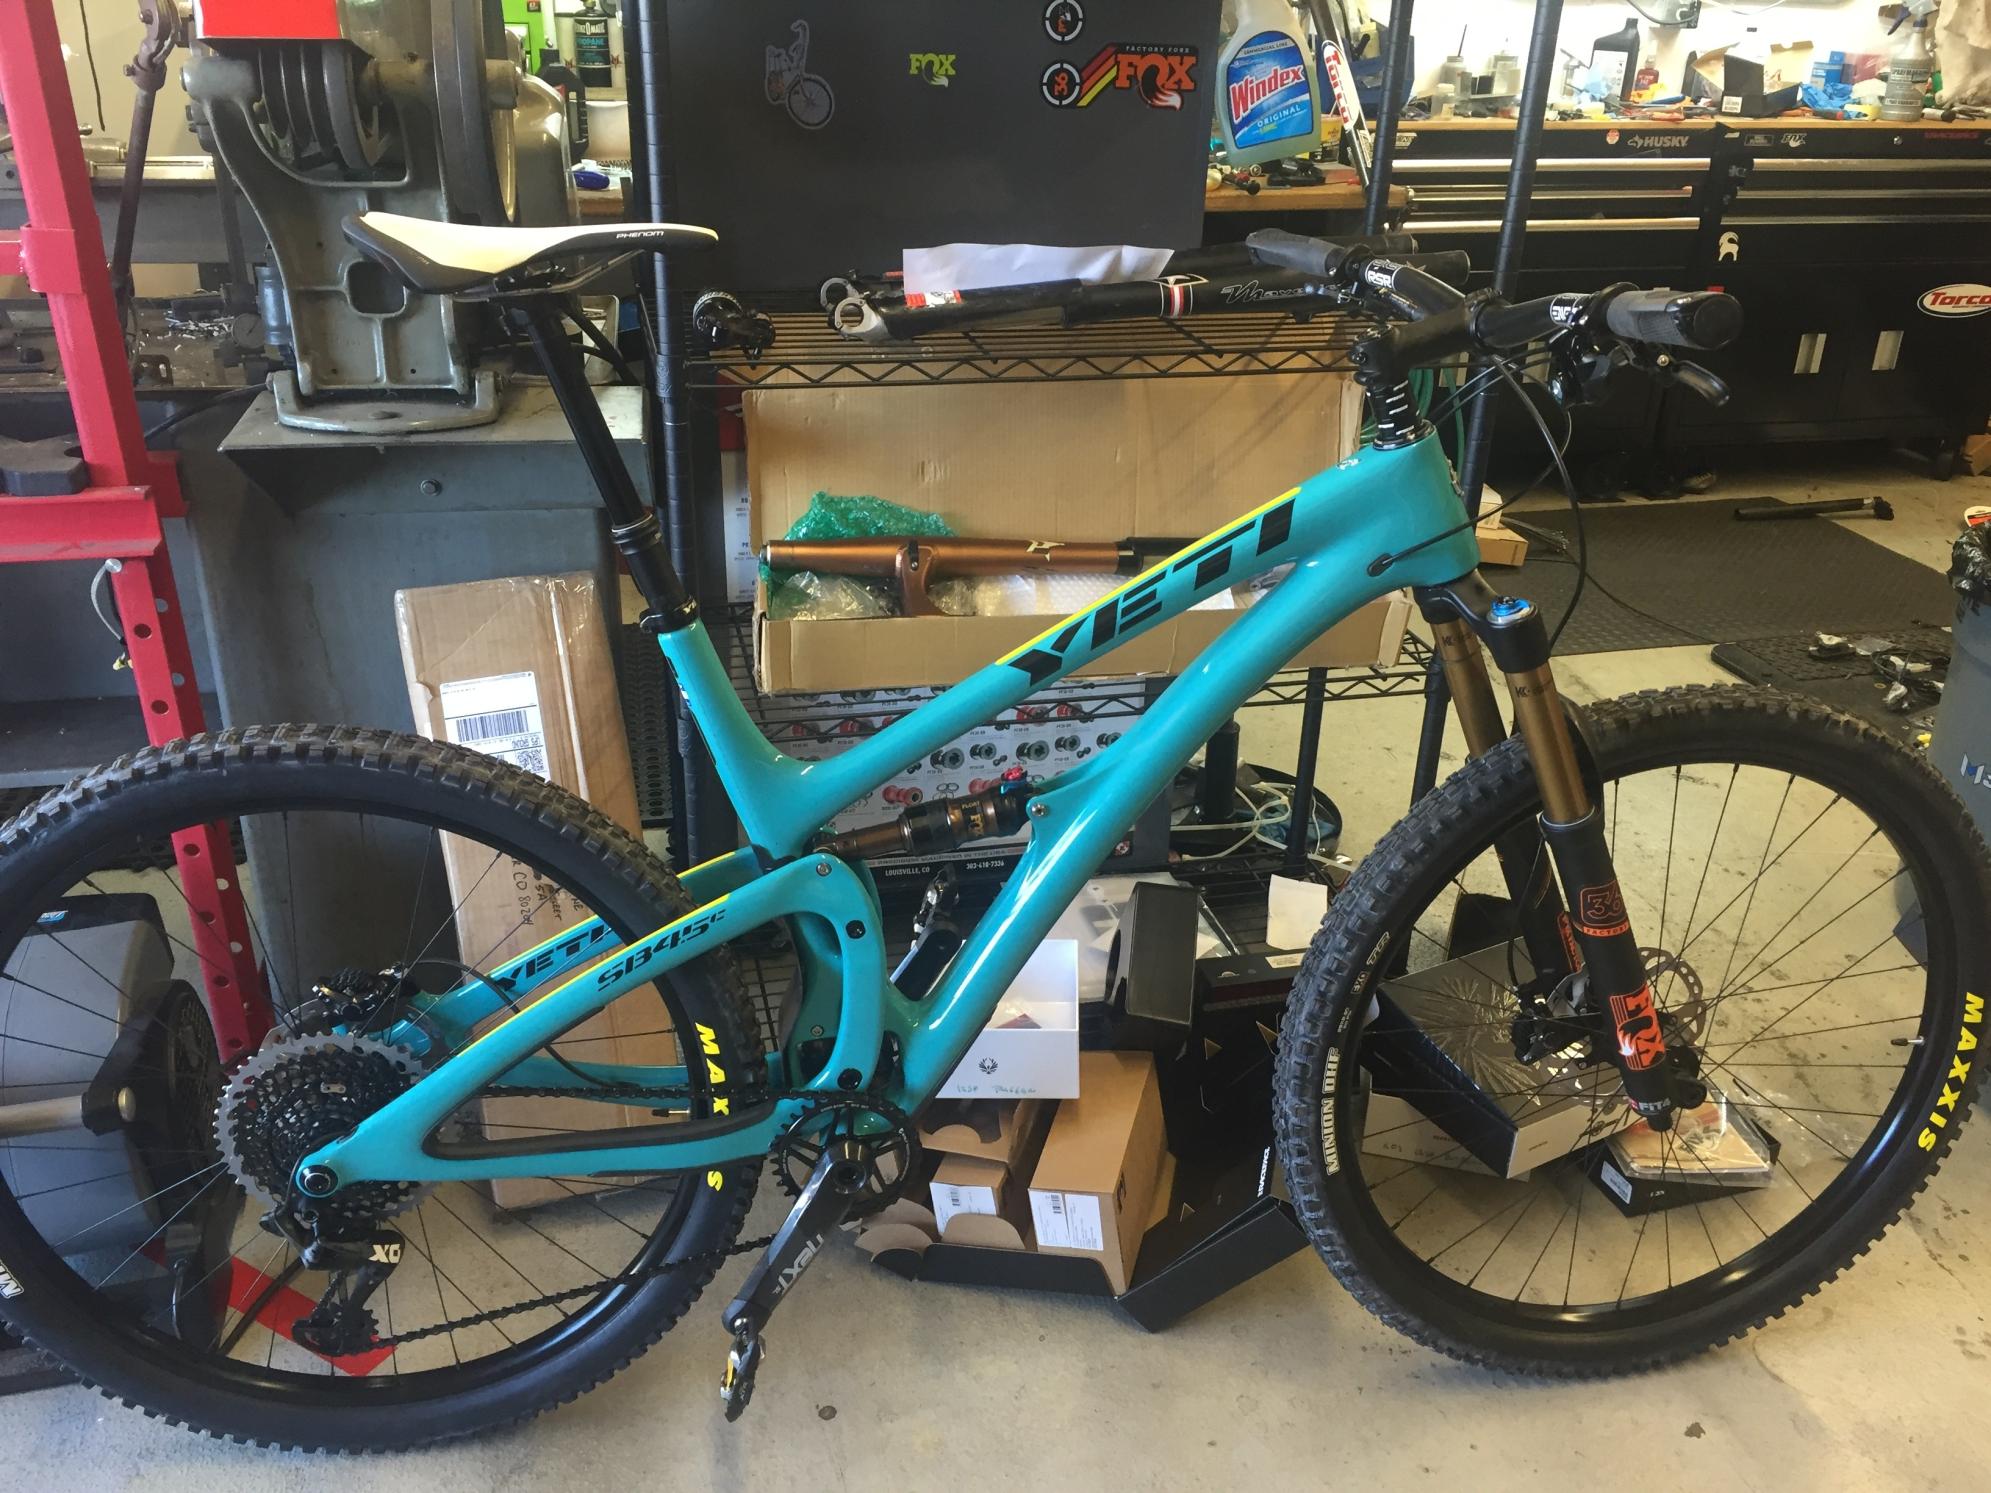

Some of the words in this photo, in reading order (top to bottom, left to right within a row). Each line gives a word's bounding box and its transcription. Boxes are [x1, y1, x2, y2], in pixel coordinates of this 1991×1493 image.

[909, 53, 956, 88] FOX
[1054, 72, 1069, 96] 36
[1115, 53, 1197, 111] FOX
[1229, 64, 1305, 125] Windex
[1256, 105, 1301, 128] ORIGINAL
[1643, 135, 1690, 148] HUSKY
[615, 230, 665, 240] PHENOM
[1008, 497, 1297, 688] YETI
[885, 867, 921, 877] LOUISVILLE,
[921, 866, 931, 874] CO
[1586, 880, 1624, 921] 36
[1618, 985, 1666, 1070] FOX
[1917, 992, 1985, 1152] MAXXIS
[1321, 1097, 1340, 1176] MINION
